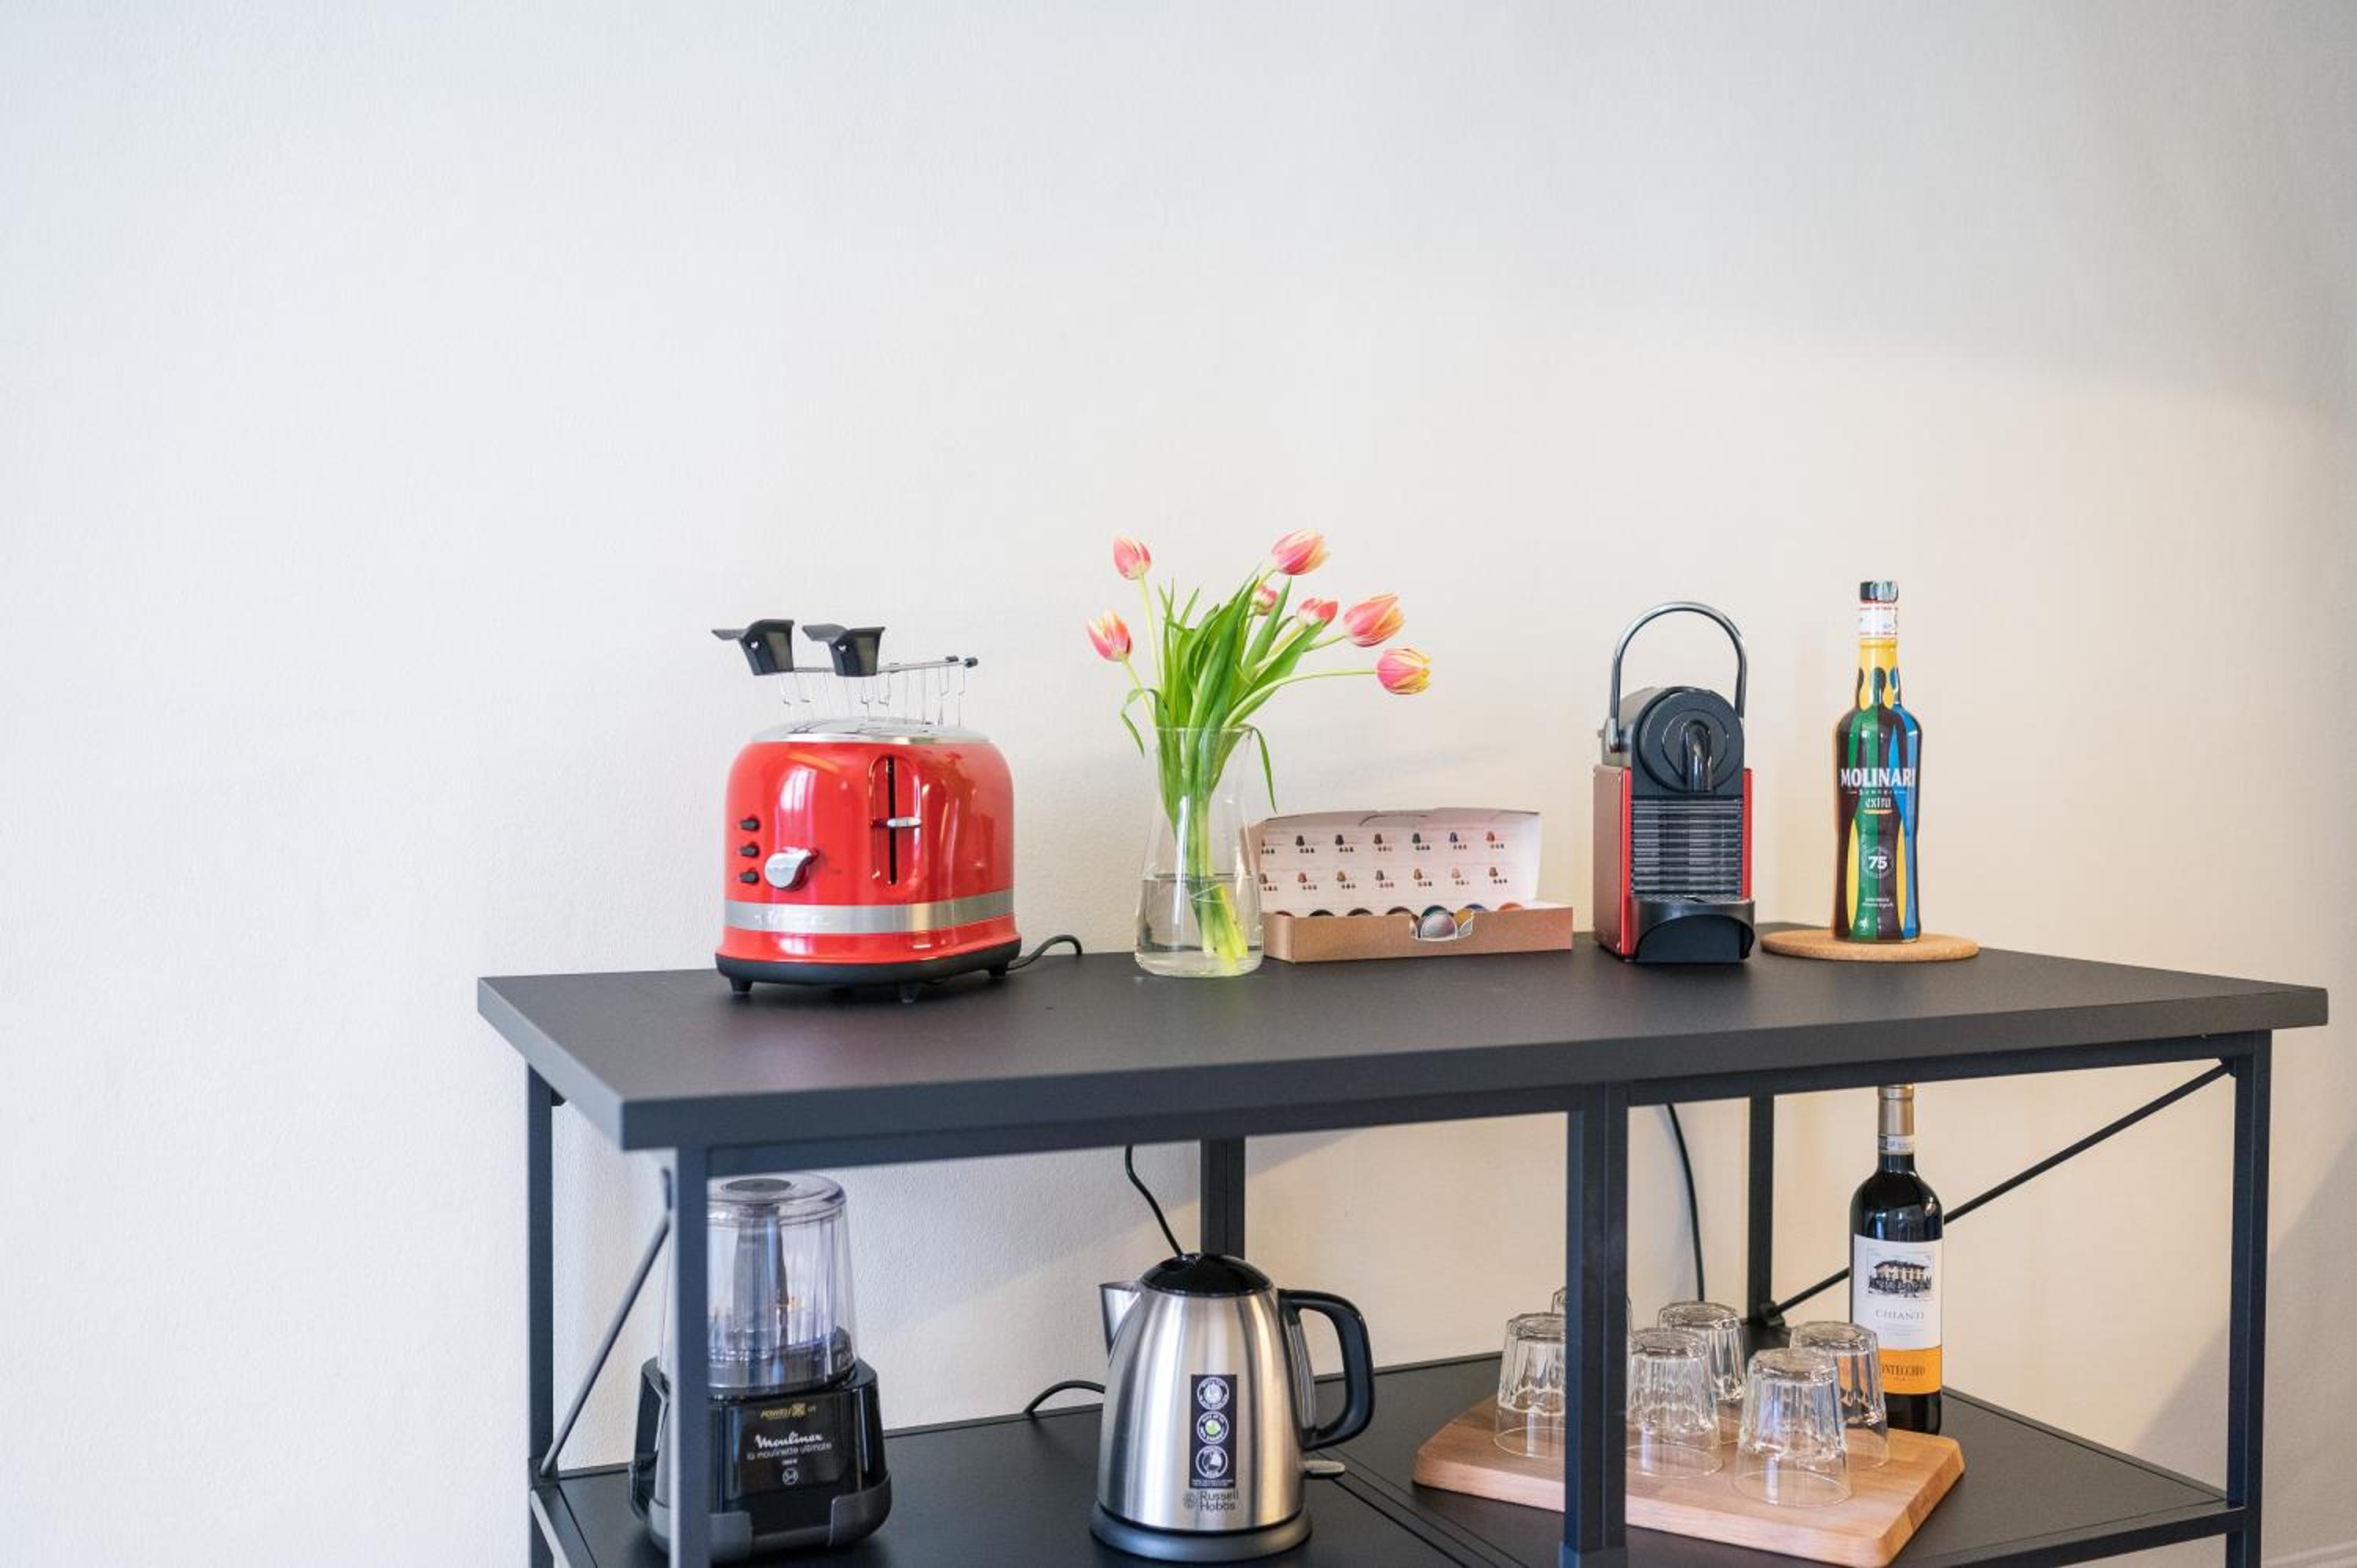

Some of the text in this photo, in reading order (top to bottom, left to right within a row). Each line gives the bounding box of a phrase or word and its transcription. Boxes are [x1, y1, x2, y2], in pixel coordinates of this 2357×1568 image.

[1841, 768, 1915, 787] MOLINARI
[1865, 797, 1891, 808] extra
[1868, 855, 1888, 870] 75
[1875, 1310, 1924, 1321] CHIANTI
[754, 1431, 823, 1449] Moulinex
[1200, 1489, 1239, 1501] Russell
[1200, 1500, 1236, 1511] Hobbs
